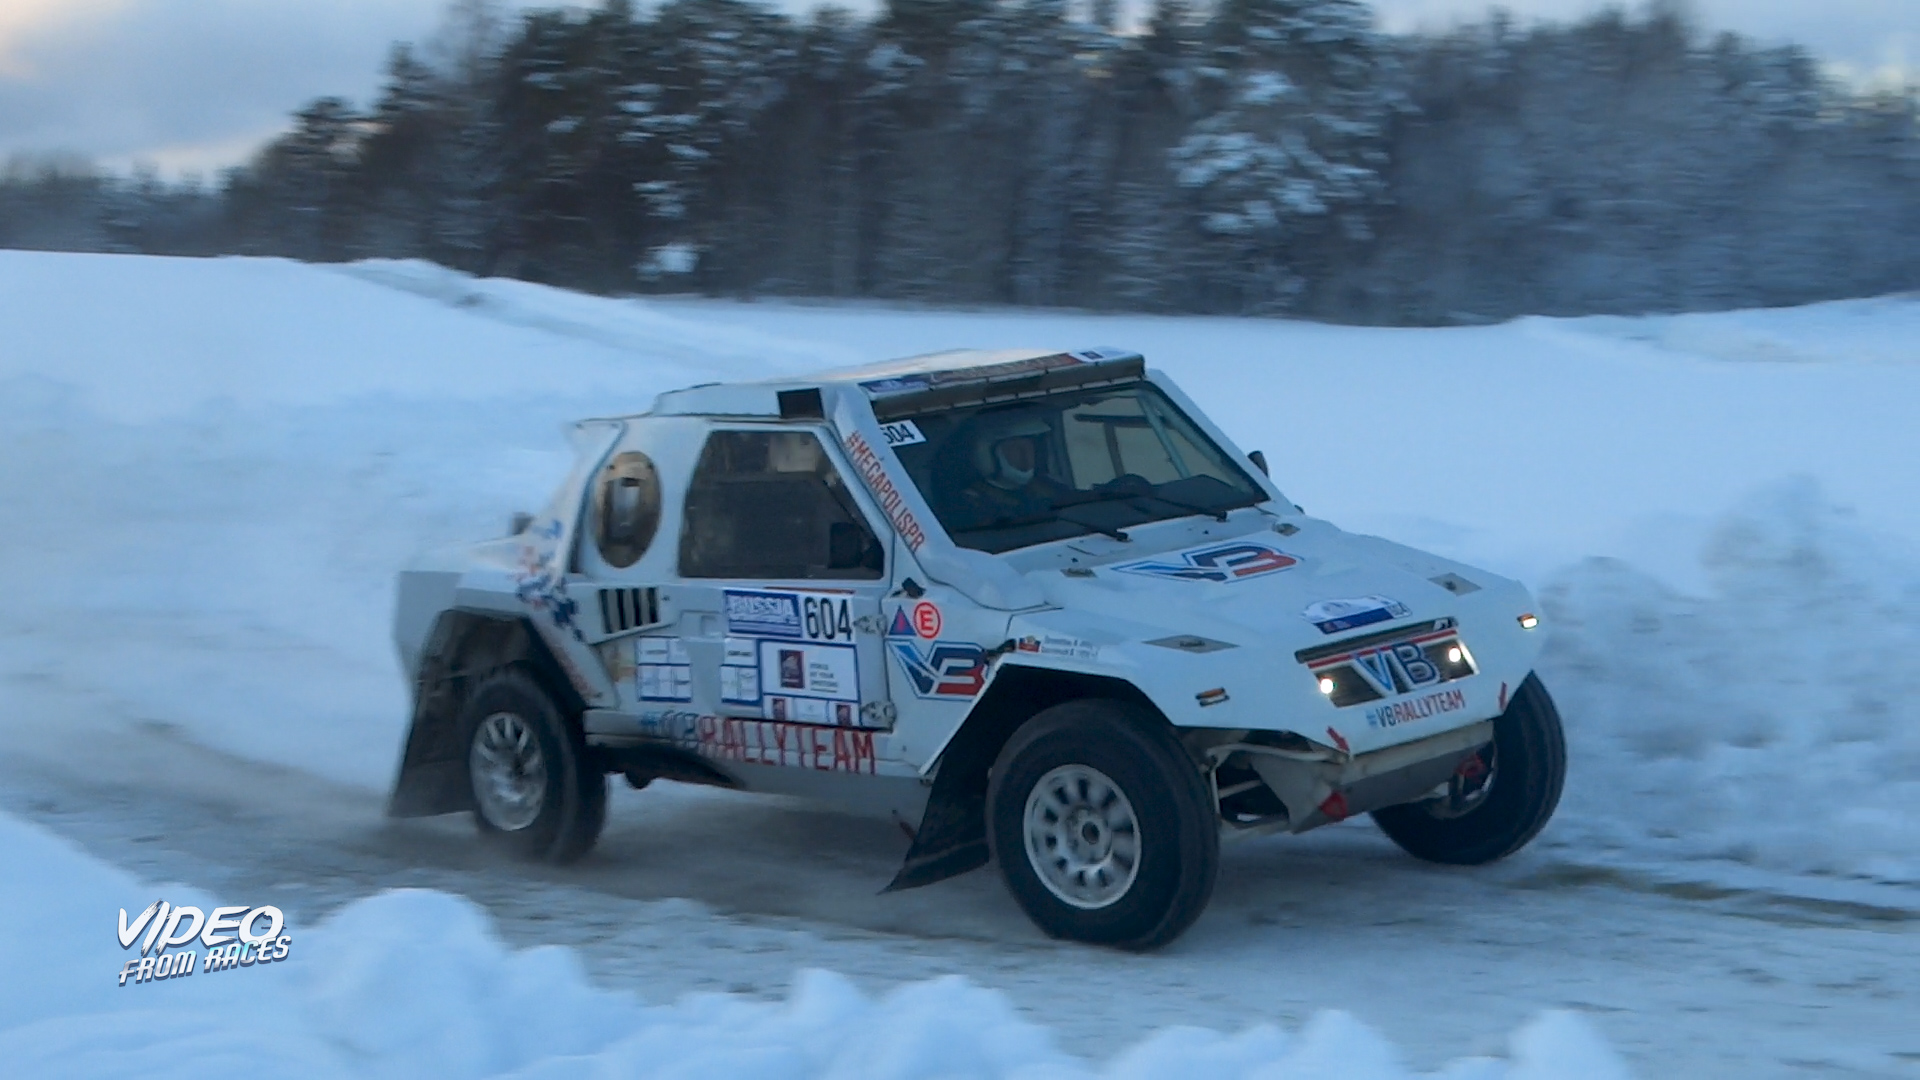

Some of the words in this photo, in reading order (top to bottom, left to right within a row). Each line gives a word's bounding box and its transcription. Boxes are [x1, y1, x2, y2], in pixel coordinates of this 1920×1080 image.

[847, 430, 925, 552] #MEGAPOLISPR
[804, 597, 852, 641] 604
[1352, 641, 1441, 695] VB
[1366, 690, 1466, 728] #VBRALLYTEAM
